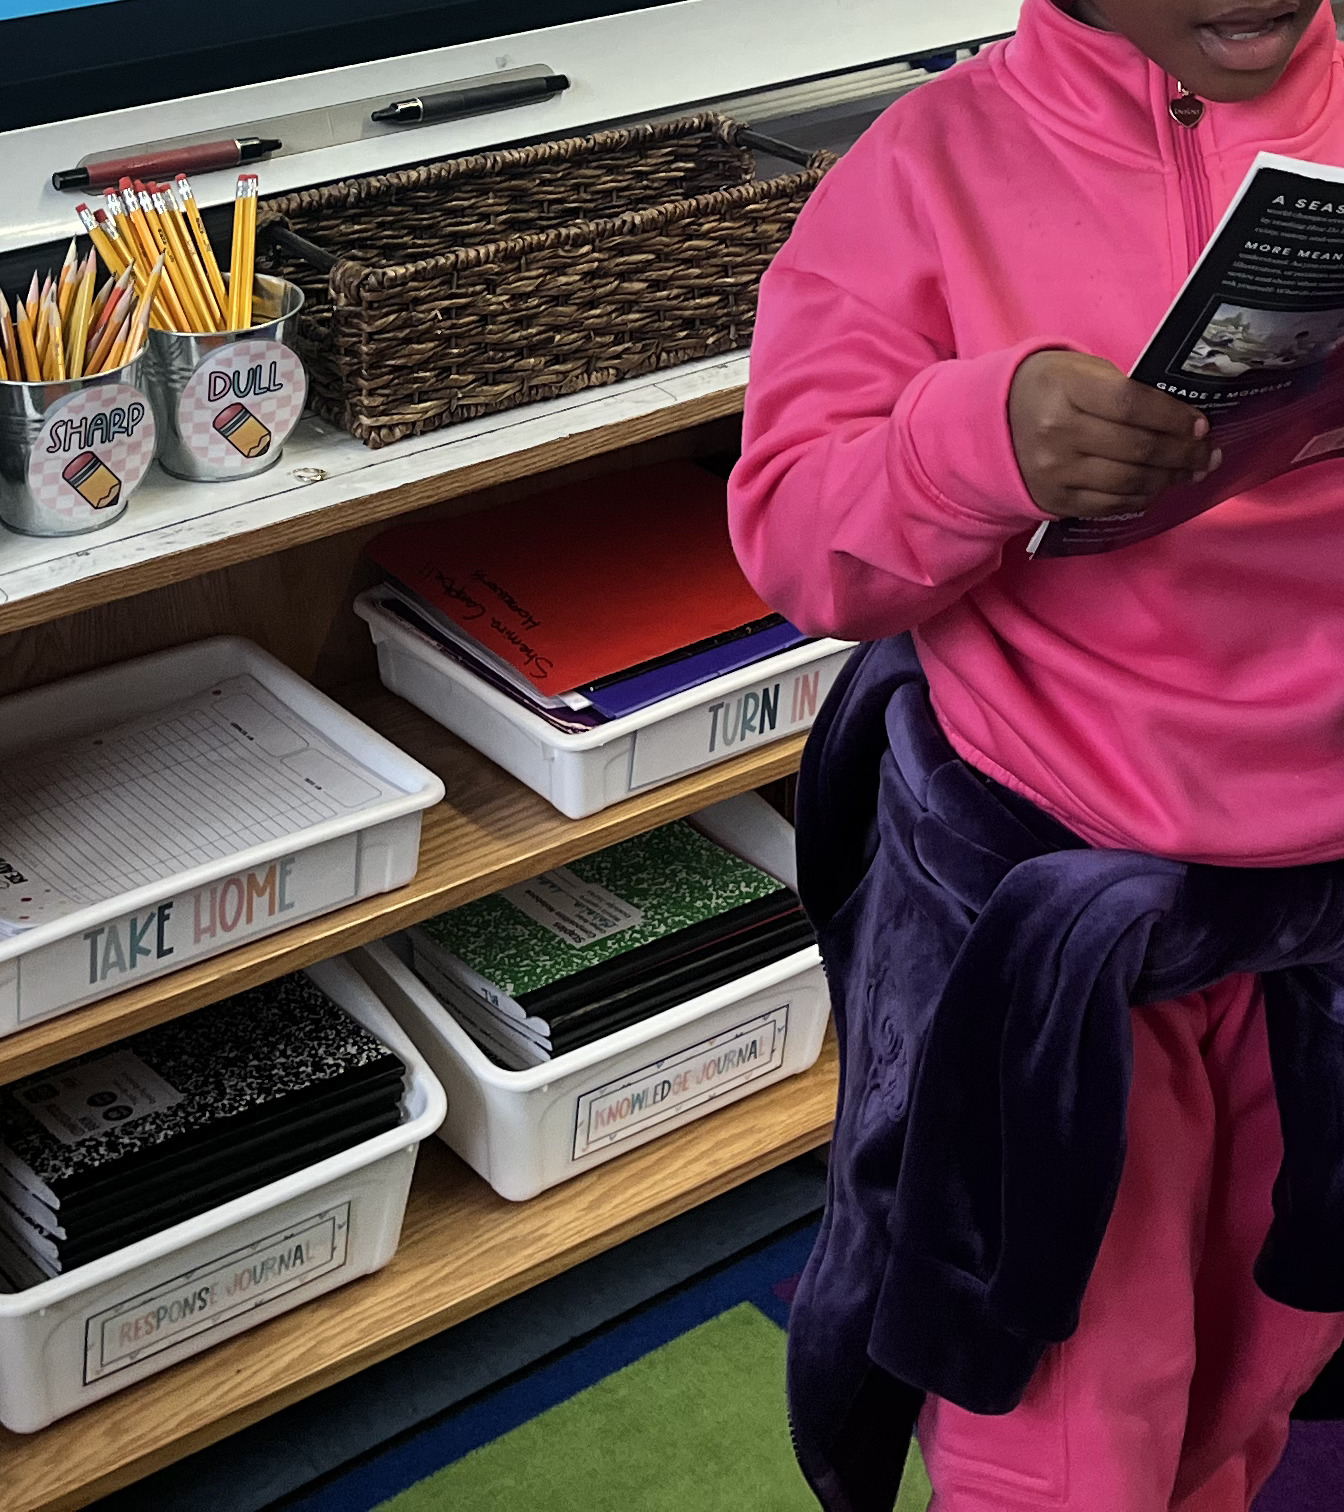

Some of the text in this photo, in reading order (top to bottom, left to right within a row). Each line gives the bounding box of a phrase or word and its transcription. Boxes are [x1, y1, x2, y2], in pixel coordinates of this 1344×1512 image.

[1272, 195, 1285, 205] A
[1245, 241, 1291, 256] MORE
[208, 361, 283, 402] DULL
[46, 402, 144, 453] SHARP
[708, 670, 819, 753] TURN IN
[82, 855, 296, 984] TAKE HOME
[594, 1036, 766, 1130] KNOWLEDGE JOURNAL
[118, 1241, 316, 1350] RESPONSE JOURNAL
